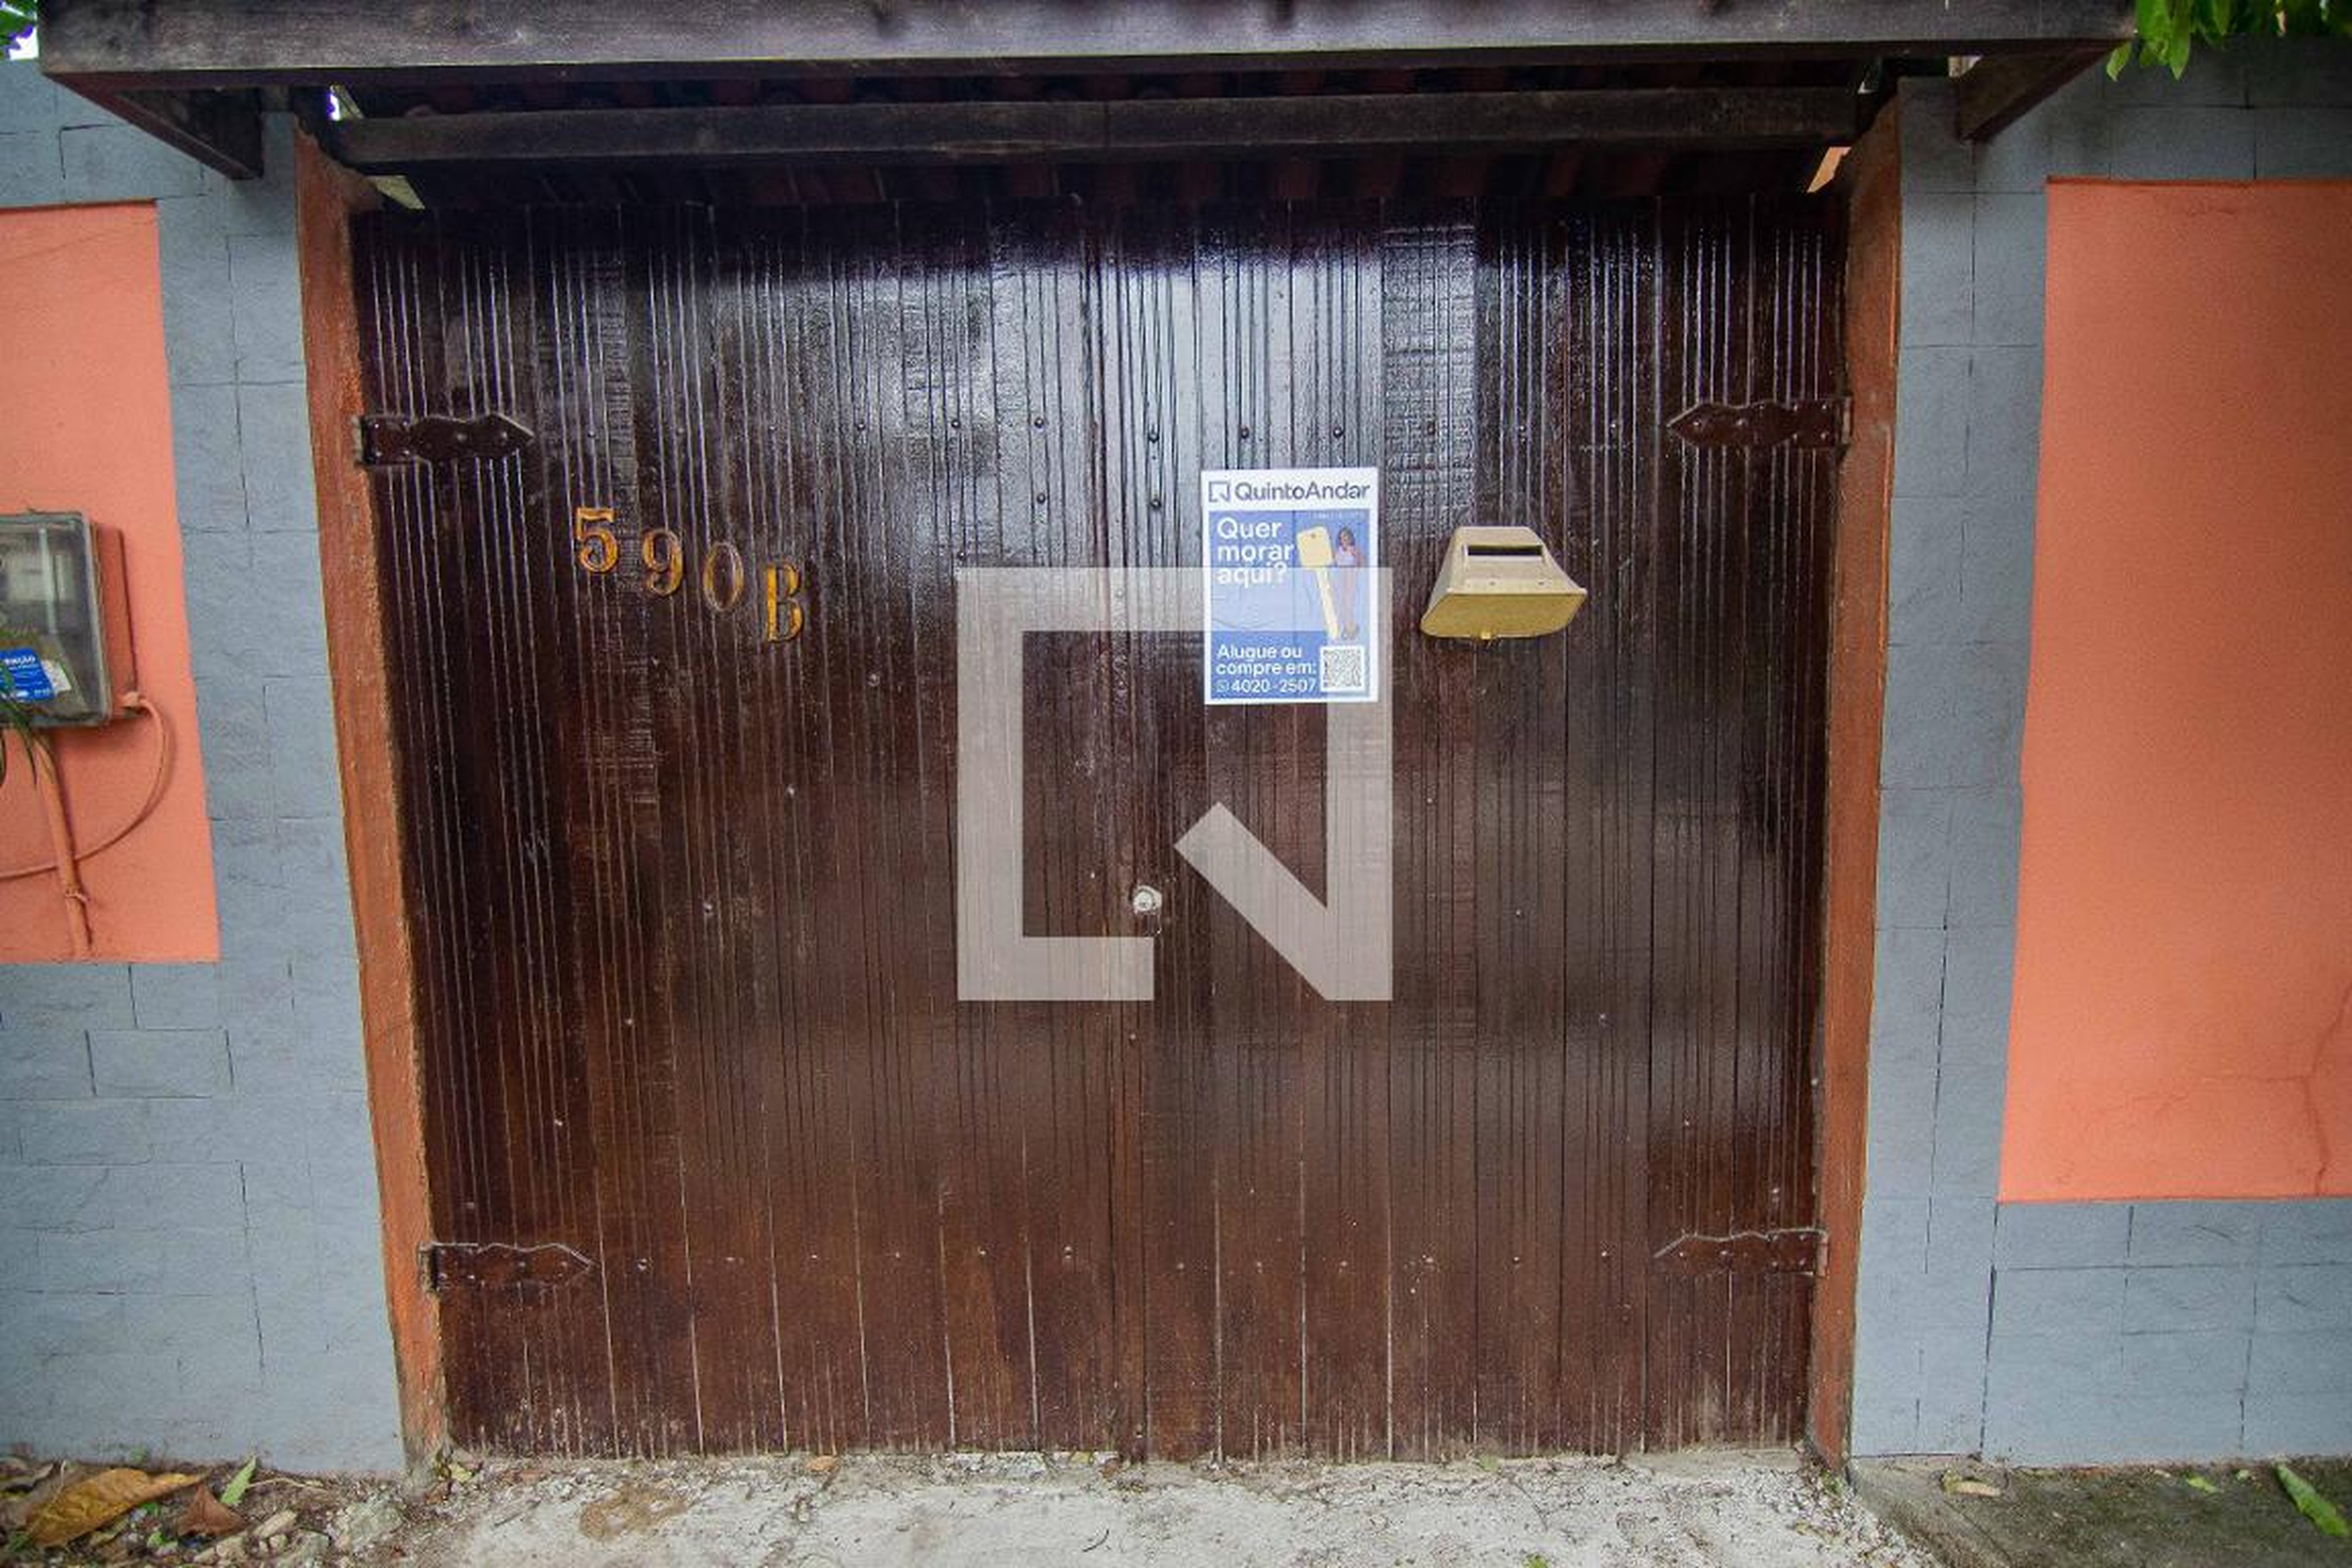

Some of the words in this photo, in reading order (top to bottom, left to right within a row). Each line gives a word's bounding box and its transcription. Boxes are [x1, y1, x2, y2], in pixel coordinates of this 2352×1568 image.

[1234, 481, 1370, 500] QuintoAndar
[1216, 517, 1282, 540] Quer
[1217, 543, 1294, 561] morar
[1217, 564, 1287, 588] aqui?
[1217, 644, 1277, 662] Alugue
[1281, 646, 1302, 658] ou
[1216, 662, 1281, 677] compre
[1286, 662, 1317, 675] em:
